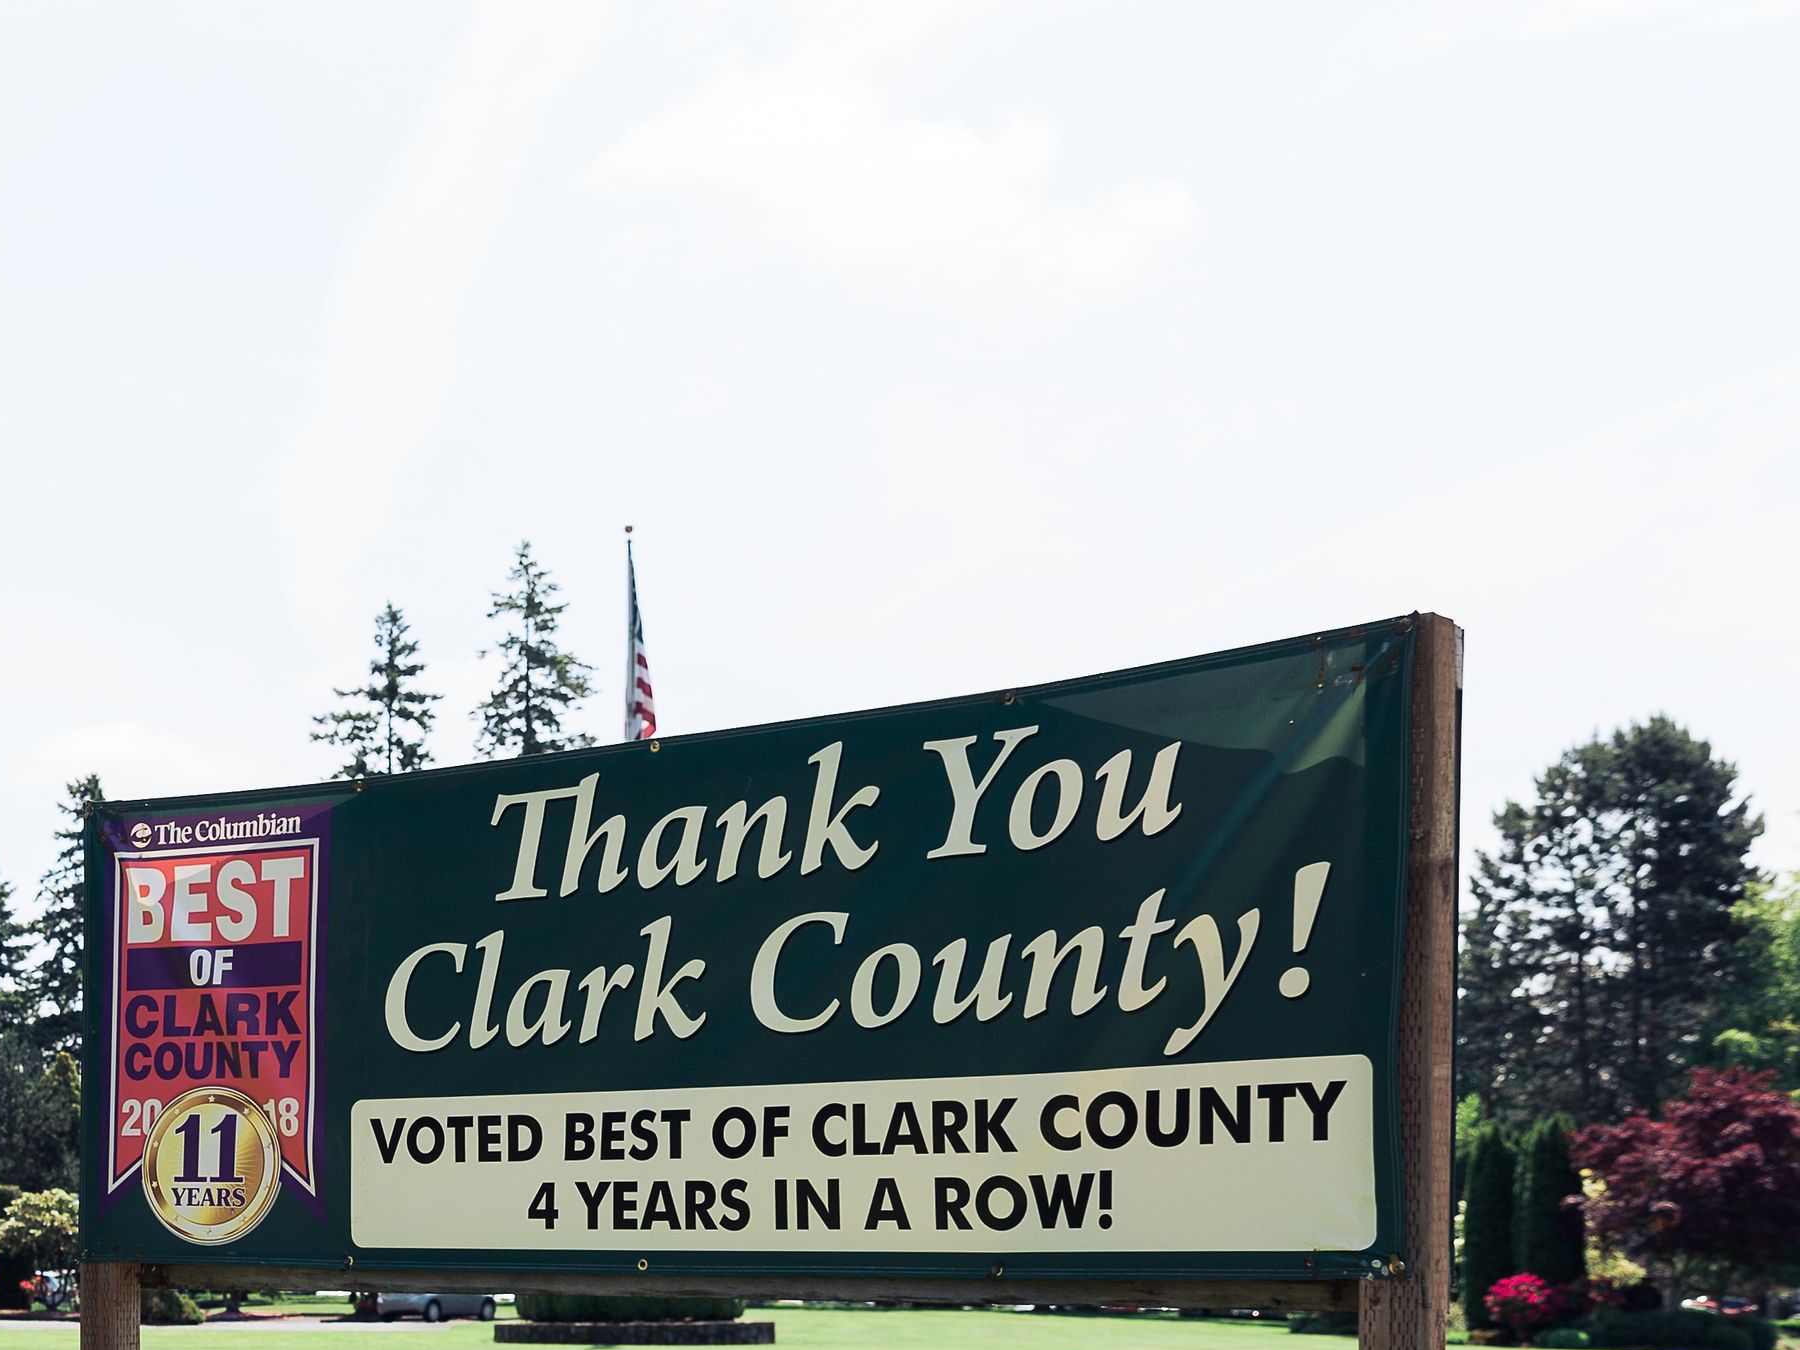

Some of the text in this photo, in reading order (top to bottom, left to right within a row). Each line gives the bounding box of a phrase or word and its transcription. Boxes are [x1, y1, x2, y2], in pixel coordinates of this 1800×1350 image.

[154, 813, 301, 846] The Columbian
[491, 724, 1183, 903] Thank You
[125, 856, 305, 944] BEST
[189, 949, 234, 987] OF
[384, 860, 1332, 1056] Clark County!
[125, 992, 302, 1039] CLARK
[124, 1040, 302, 1082] COUNTY
[173, 1114, 244, 1184] 11
[370, 1080, 1347, 1164] VOTED BEST OF CLARK COUNTY
[171, 1186, 246, 1207] YEARS
[528, 1169, 1114, 1231] 4 YEARS IN A ROW!
